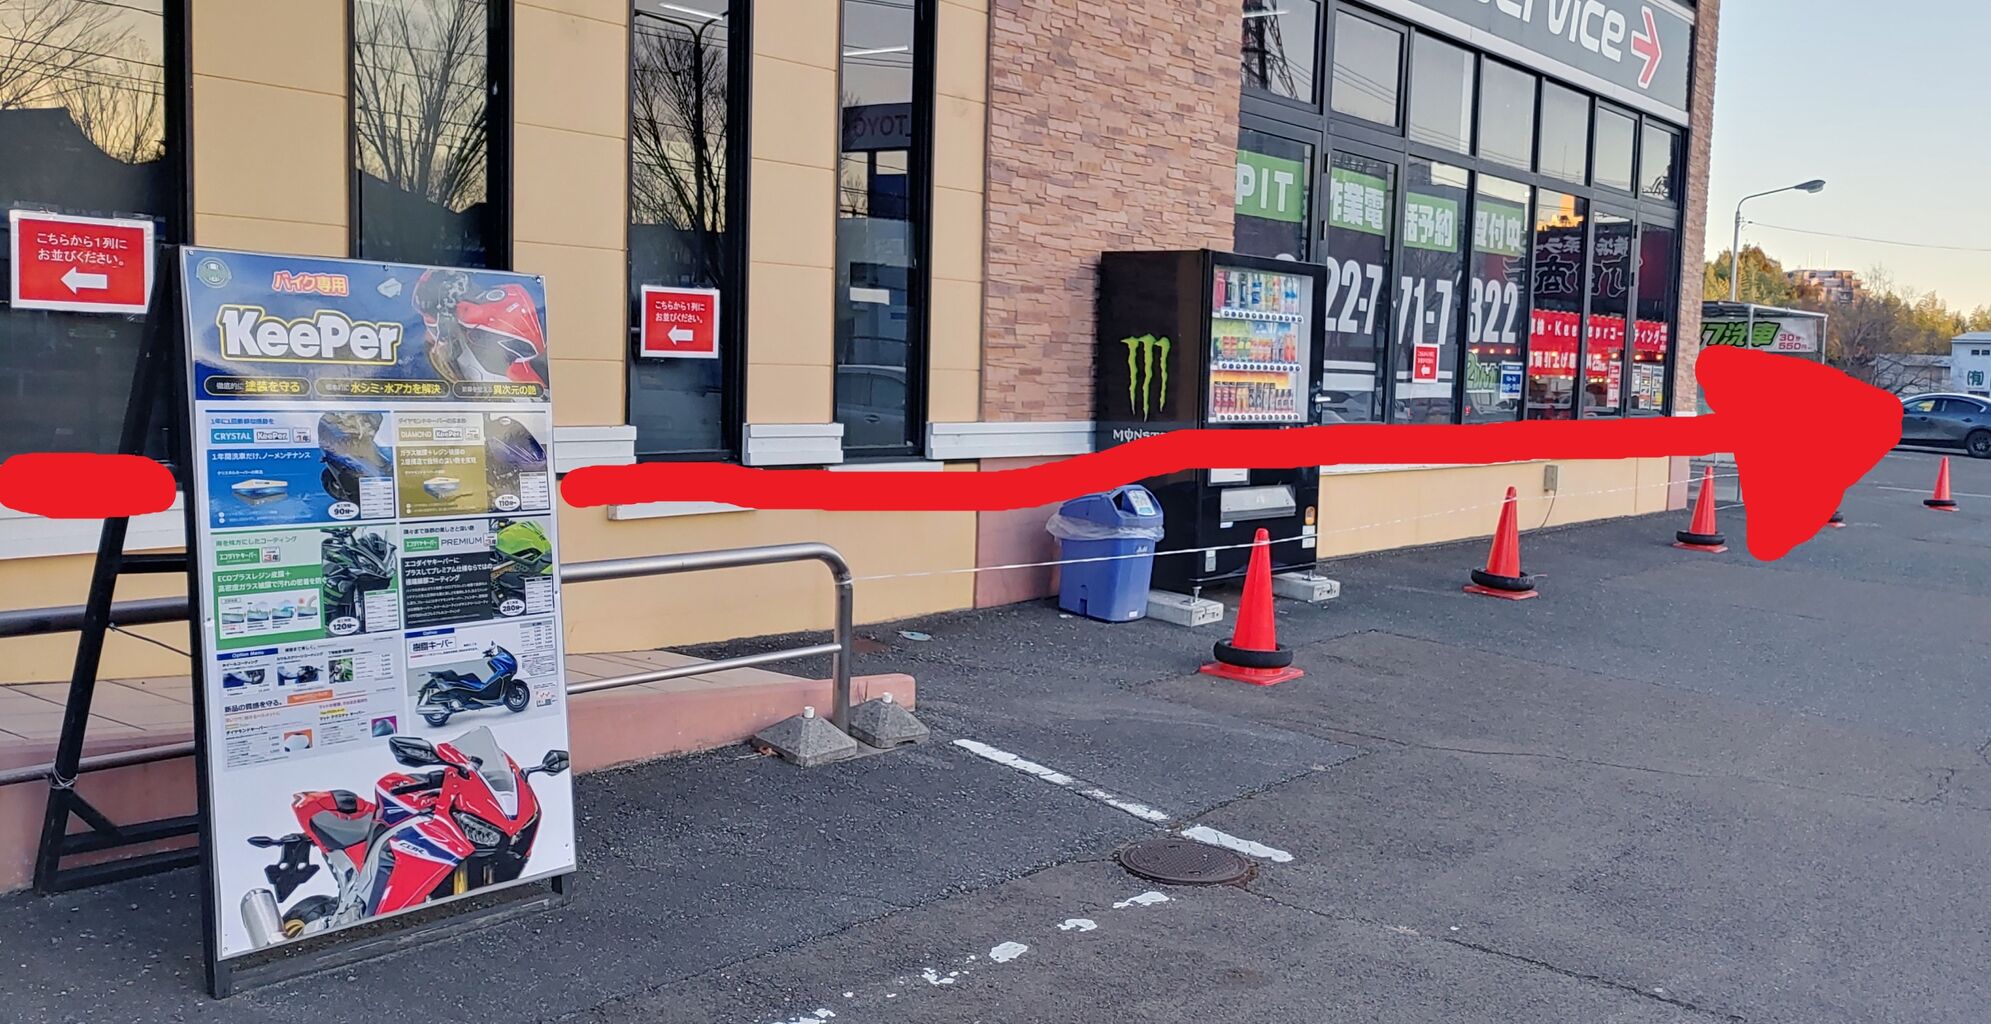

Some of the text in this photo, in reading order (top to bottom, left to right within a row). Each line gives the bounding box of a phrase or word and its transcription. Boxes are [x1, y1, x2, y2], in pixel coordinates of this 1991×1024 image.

[1478, 0, 1626, 62] vice
[1236, 164, 1294, 212] PIT
[37, 233, 128, 249] こちらから1列に
[38, 248, 124, 266] お並びください。
[274, 272, 348, 296] バイク専用
[655, 301, 705, 312] こちらから1列に
[655, 313, 703, 324] お並びください。
[220, 308, 401, 362] KeePer
[213, 432, 252, 441] CRYSTAL
[400, 430, 432, 438] DIAMOND
[441, 537, 482, 546] PREMIUM
